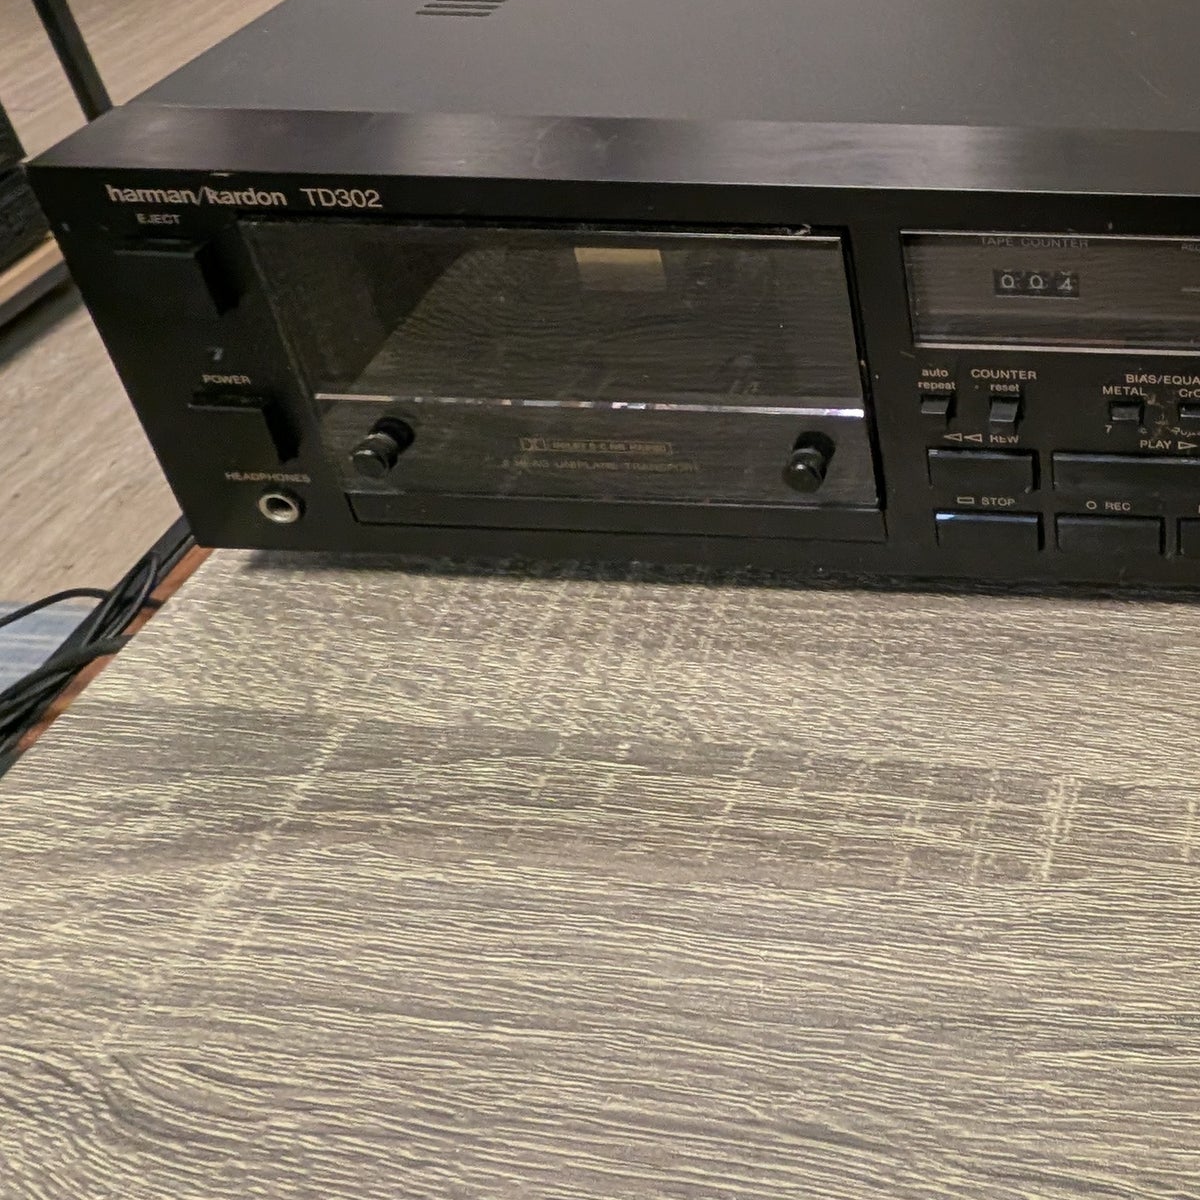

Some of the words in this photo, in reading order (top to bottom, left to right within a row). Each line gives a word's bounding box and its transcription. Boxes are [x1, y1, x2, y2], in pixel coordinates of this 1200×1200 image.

[105, 184, 288, 206] harman/kardon
[299, 188, 383, 208] TD302
[136, 213, 181, 225] EJECT
[980, 237, 1014, 248] TAPE
[1021, 238, 1090, 249] COUNTER
[922, 368, 949, 378] auto
[970, 368, 1037, 380] COUNTER
[202, 374, 251, 385] POWER
[918, 381, 956, 390] repeat
[990, 383, 1020, 392] reset
[1102, 386, 1147, 397] METAL
[989, 434, 1020, 444] REW
[1139, 439, 1172, 449] PLAY
[224, 472, 312, 483] HEADPHONES
[981, 496, 1016, 507] STOP
[1104, 501, 1131, 511] REC
